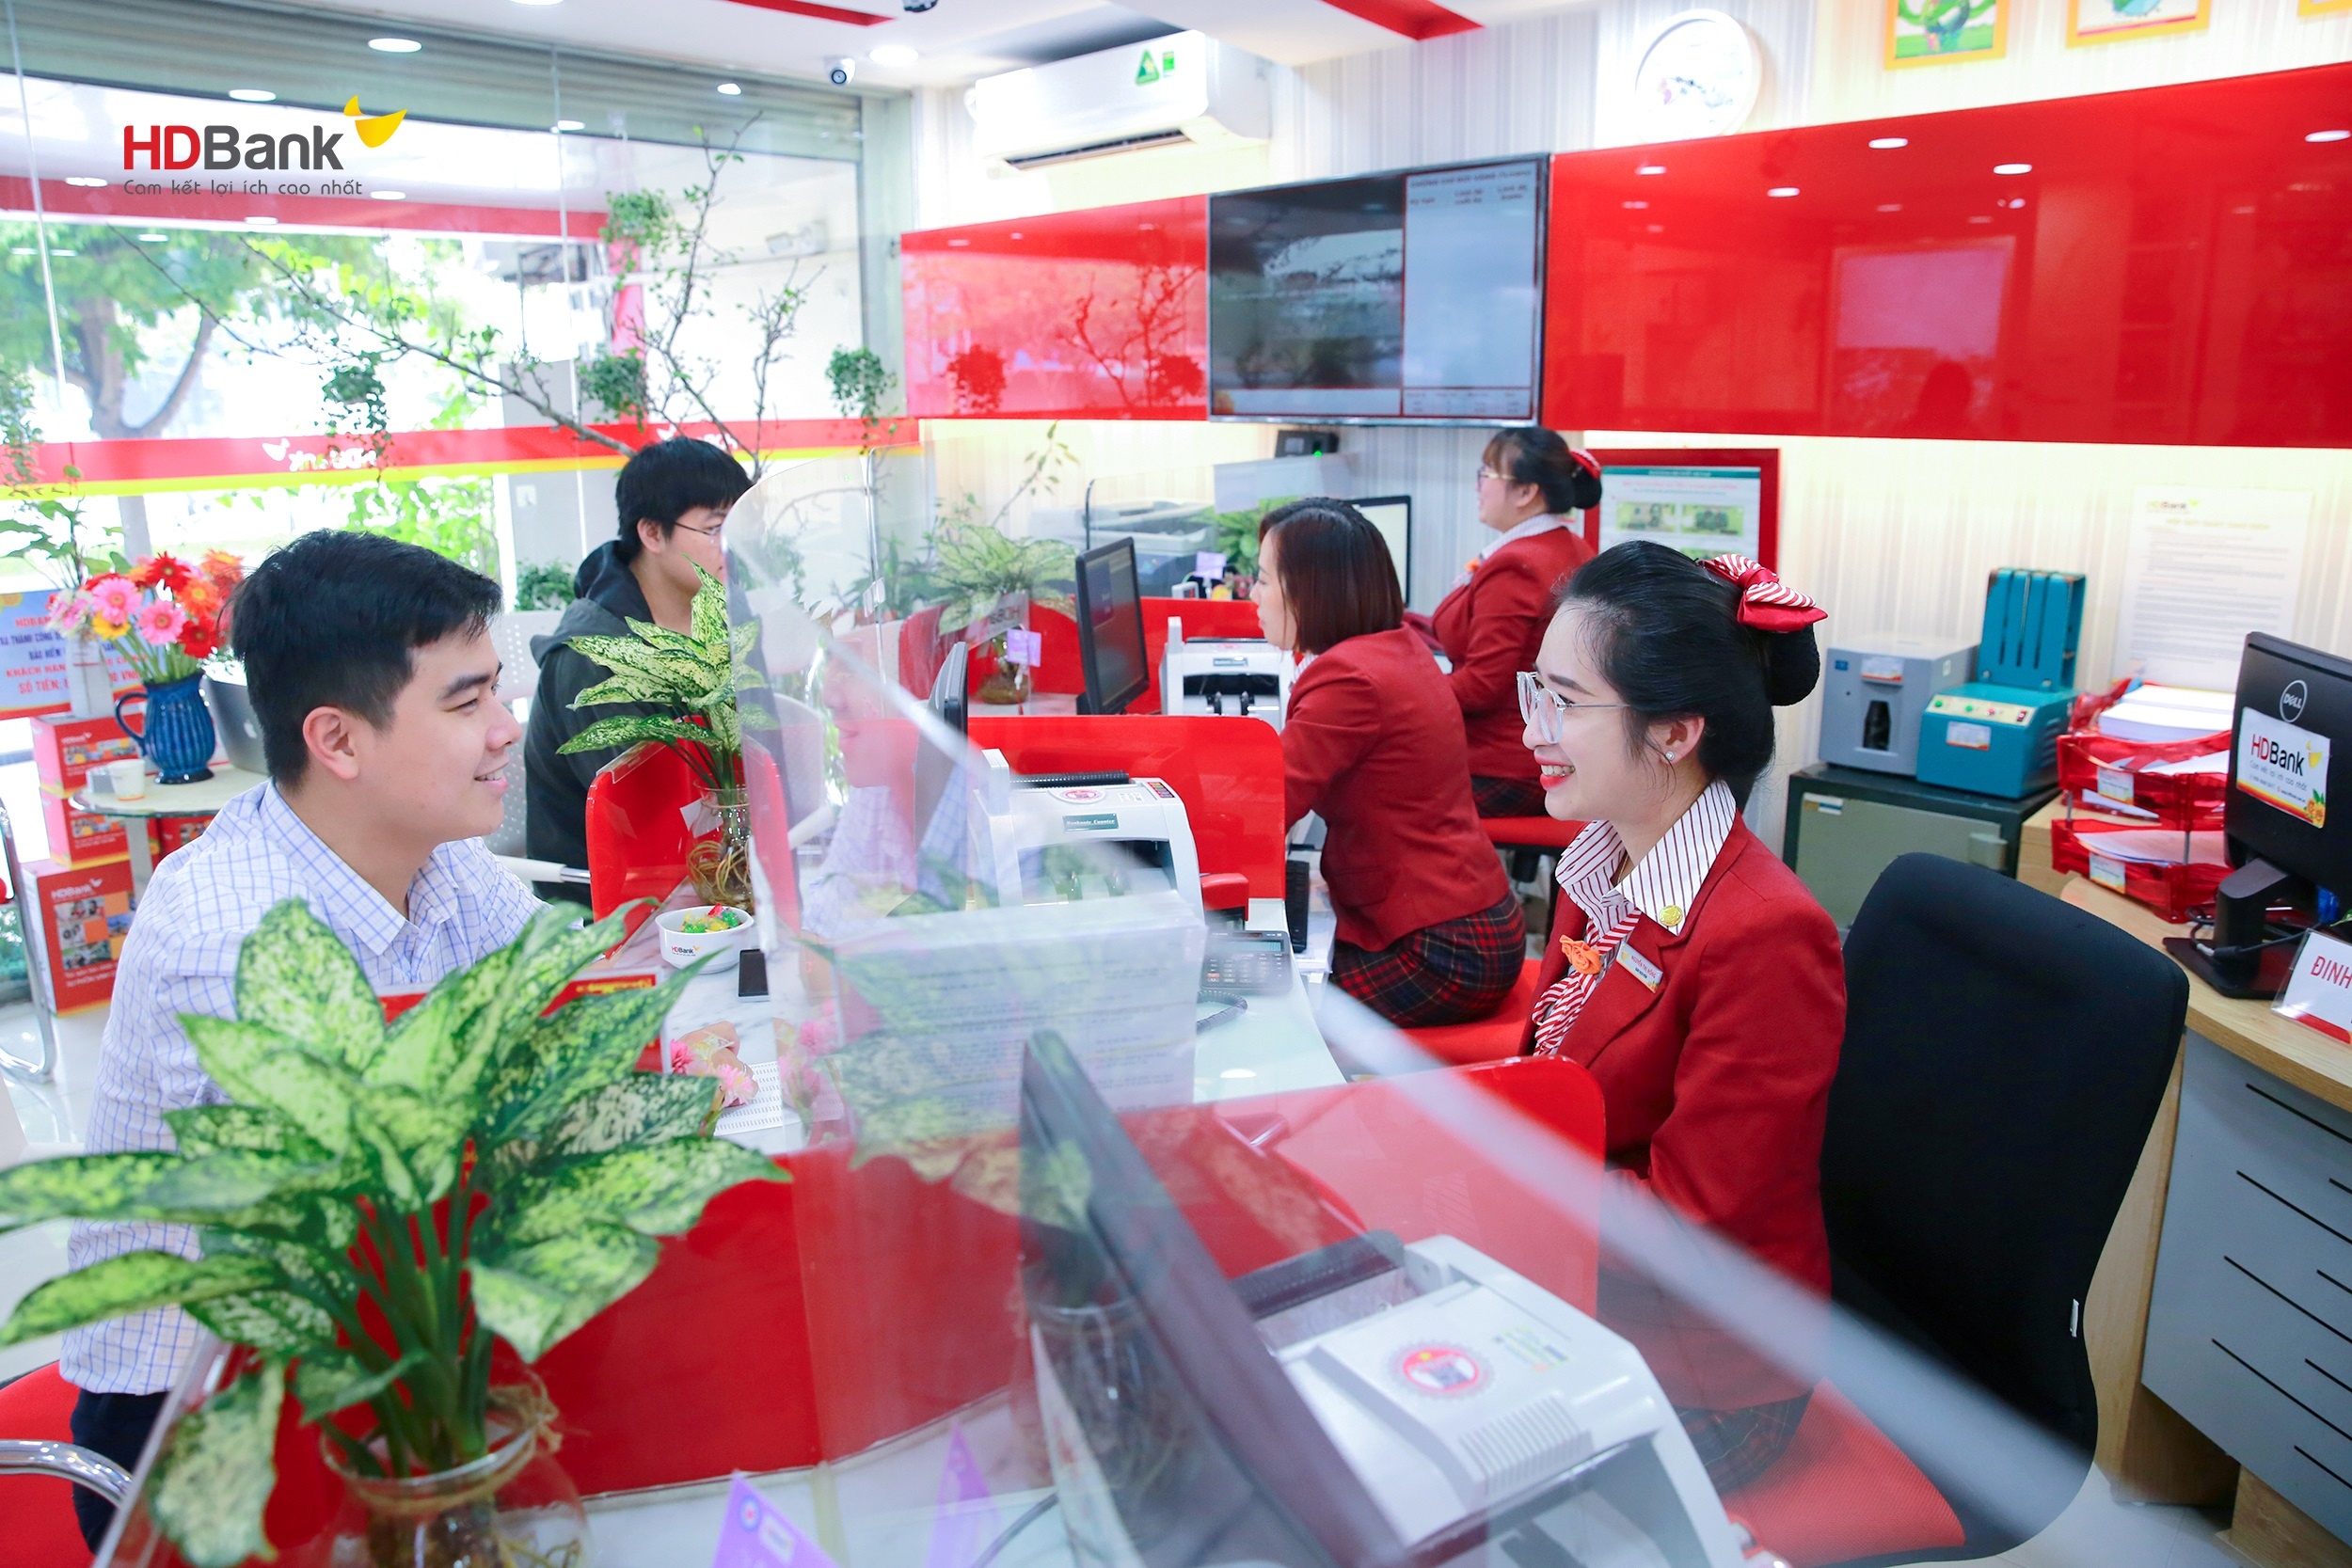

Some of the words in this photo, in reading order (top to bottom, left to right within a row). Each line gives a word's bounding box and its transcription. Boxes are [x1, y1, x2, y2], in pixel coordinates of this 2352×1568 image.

[2283, 693, 2303, 709] DELL
[2250, 734, 2305, 777] HDBank
[2311, 955, 2352, 990] ĐINH
